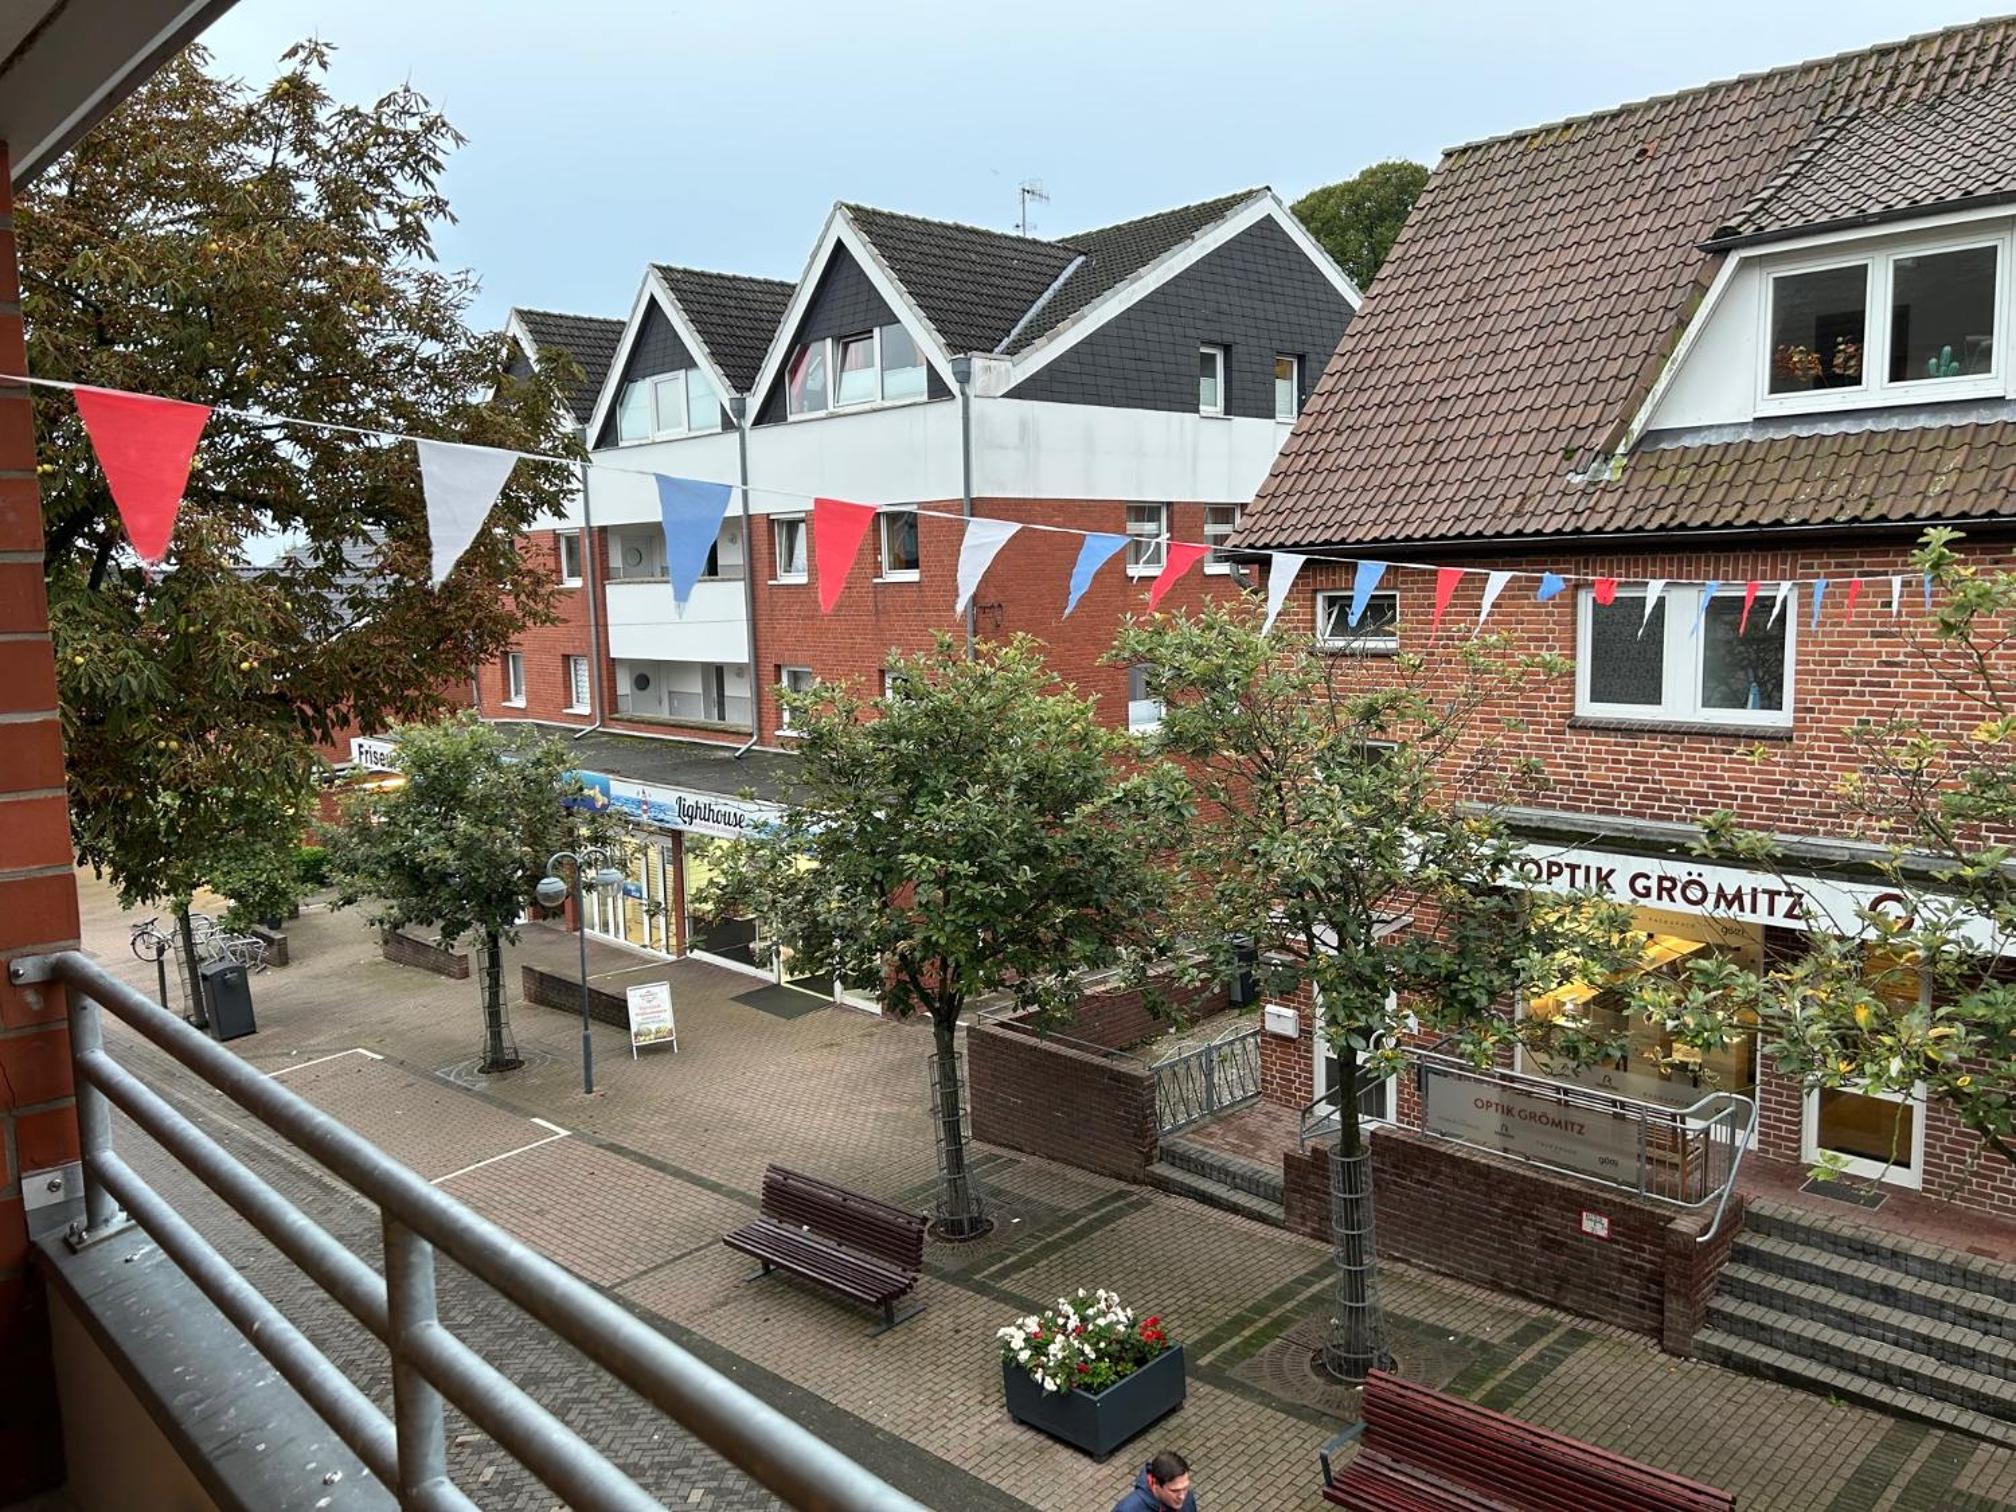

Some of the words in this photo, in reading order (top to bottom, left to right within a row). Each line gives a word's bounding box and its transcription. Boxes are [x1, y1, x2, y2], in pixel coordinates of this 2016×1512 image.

[358, 743, 399, 767] Frise
[675, 795, 746, 829] Lighthouse
[1518, 858, 1616, 895] OPTIK
[1628, 870, 1805, 920] GRÖMITZ
[1474, 1098, 1516, 1118] OPTIK
[1517, 1108, 1587, 1136] GRÖMITZ
